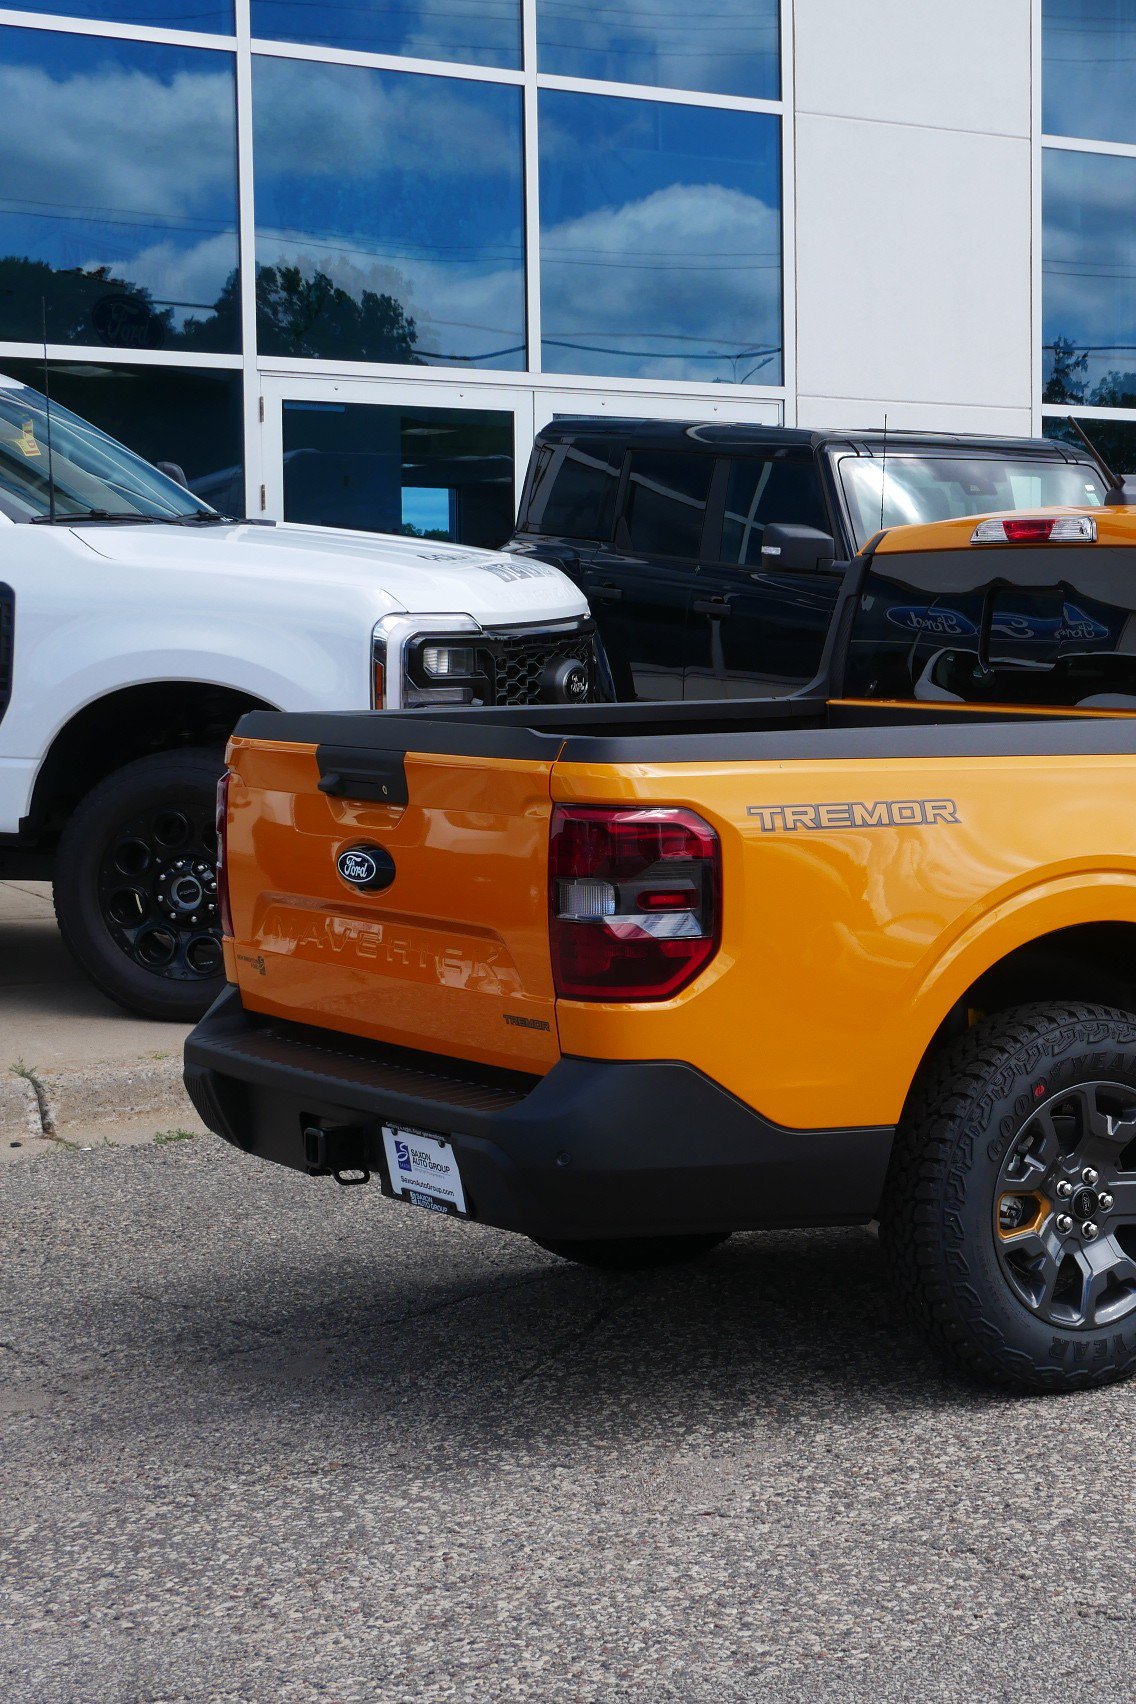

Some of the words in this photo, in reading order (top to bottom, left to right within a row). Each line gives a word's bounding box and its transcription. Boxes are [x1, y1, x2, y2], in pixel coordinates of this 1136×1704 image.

[746, 799, 962, 832] TREMOR
[344, 855, 368, 878] Ford
[270, 914, 504, 980] MAVERICK
[503, 1014, 551, 1032] TREMOR
[410, 1148, 431, 1161] SAXON
[412, 1157, 428, 1168] AUTO
[428, 1161, 451, 1173] GROUP
[416, 1192, 433, 1203] SAXON
[417, 1200, 431, 1209] AUTO
[431, 1203, 448, 1213] GROUP
